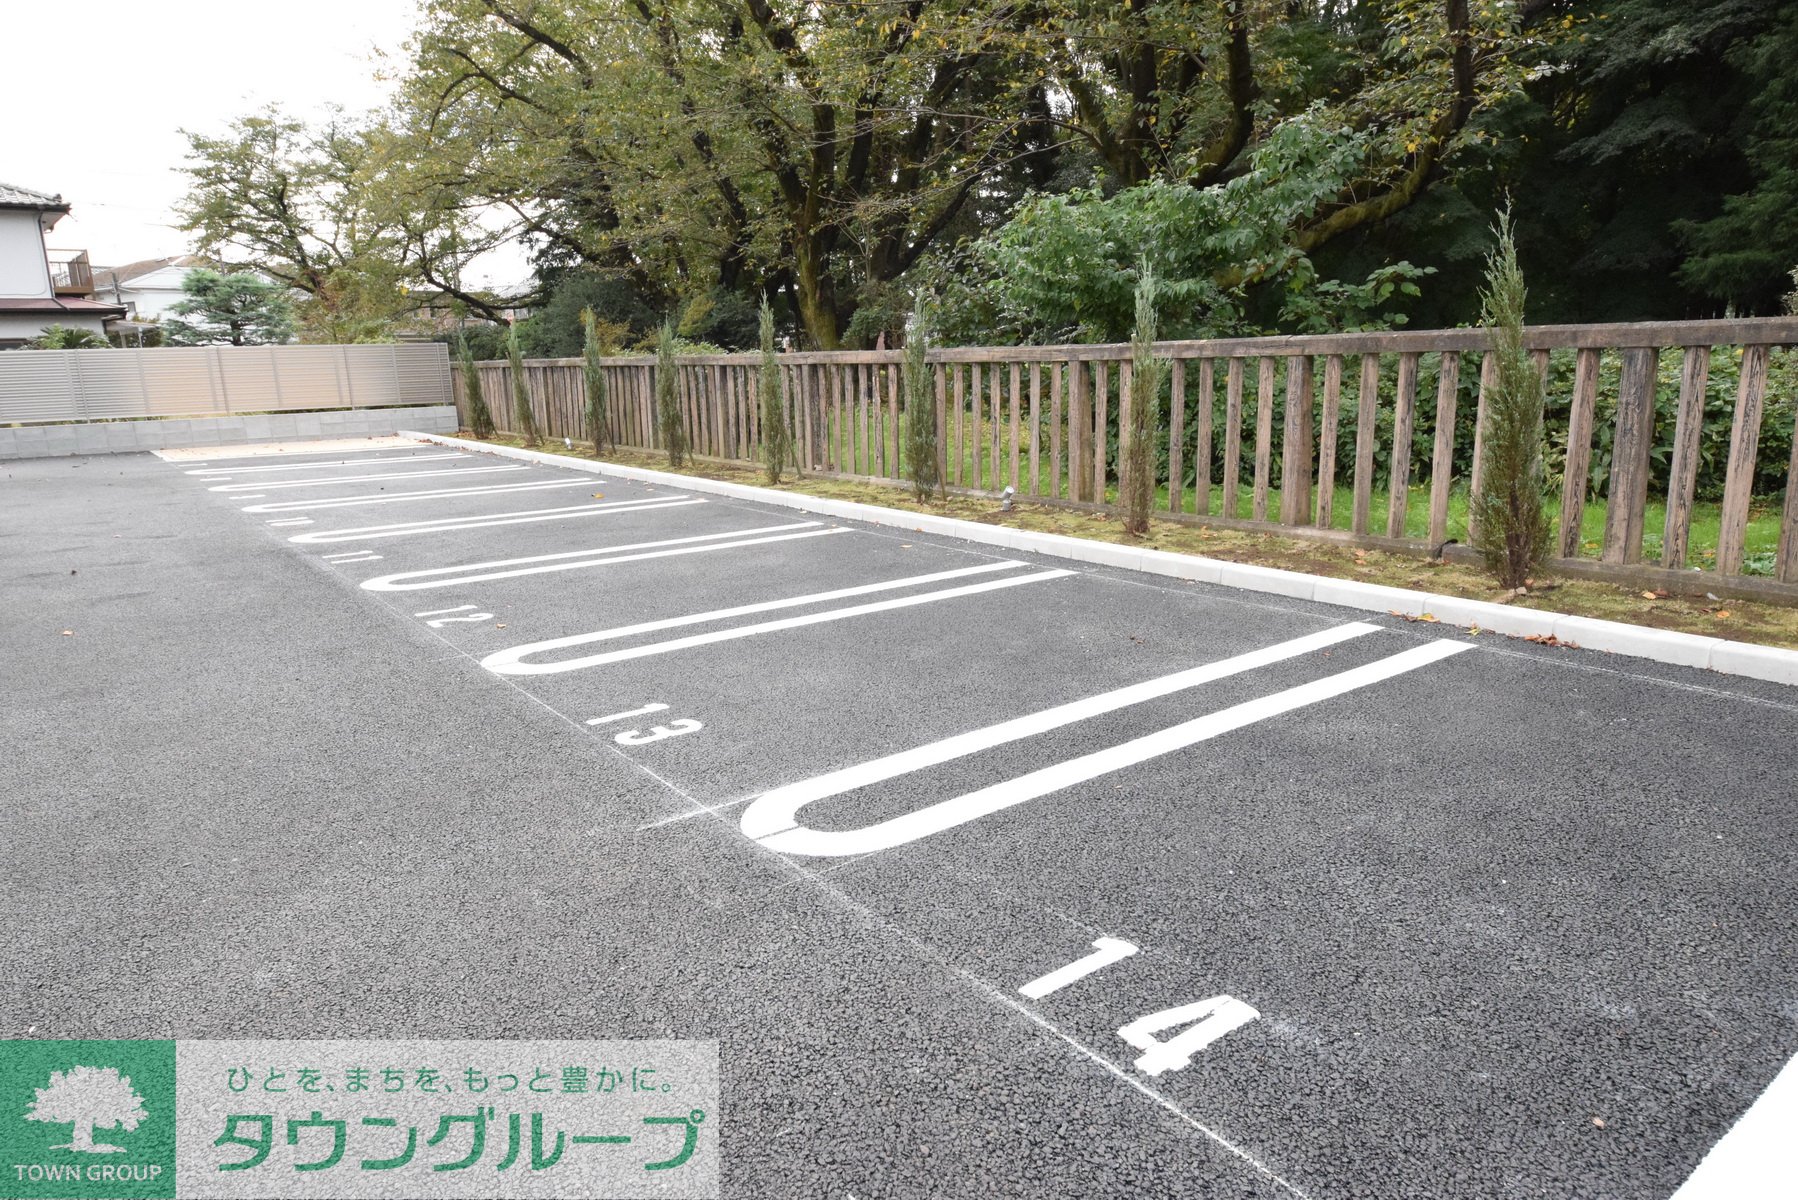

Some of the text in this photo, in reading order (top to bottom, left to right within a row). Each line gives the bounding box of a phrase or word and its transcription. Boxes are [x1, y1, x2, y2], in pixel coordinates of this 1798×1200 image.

[414, 604, 494, 628] 12
[586, 703, 703, 746] 13
[1018, 937, 1262, 1076] 14
